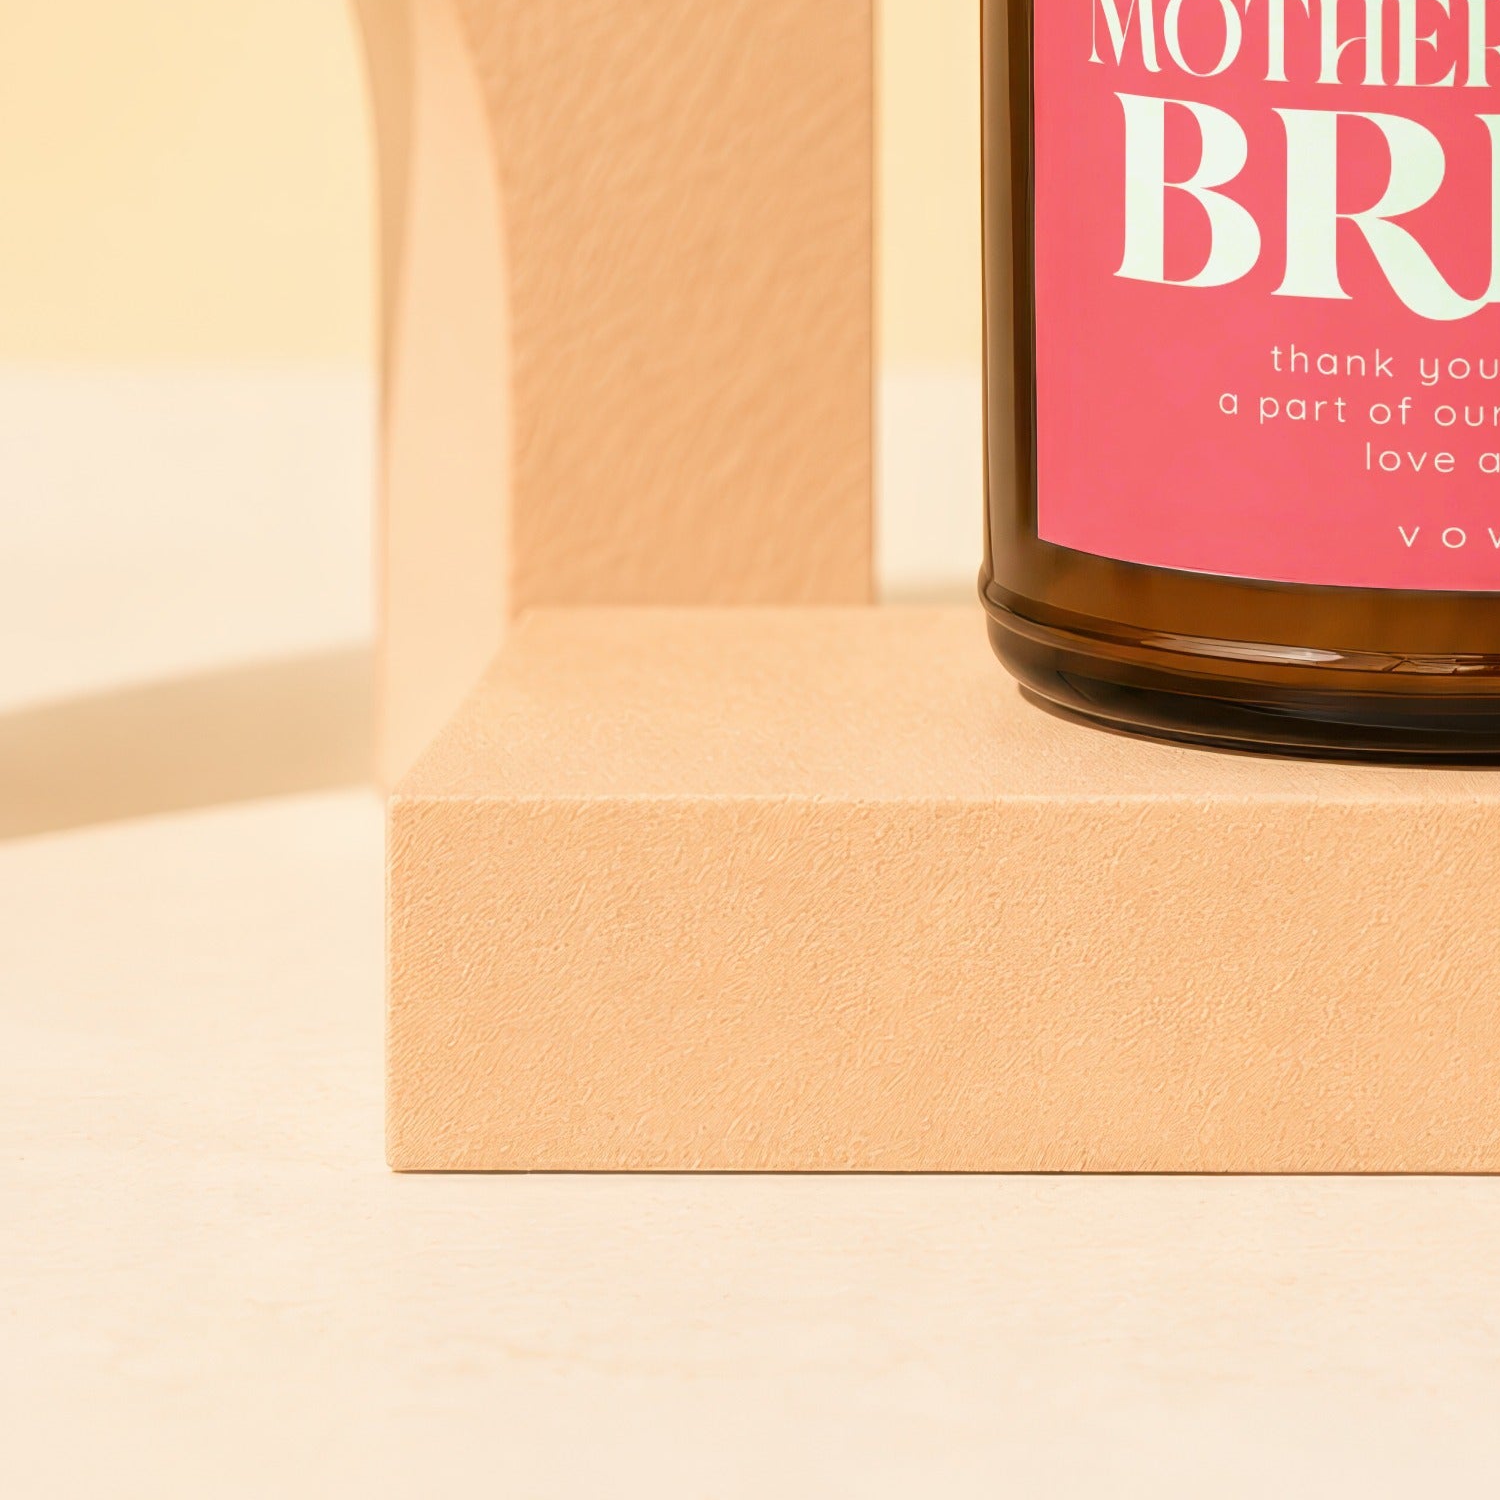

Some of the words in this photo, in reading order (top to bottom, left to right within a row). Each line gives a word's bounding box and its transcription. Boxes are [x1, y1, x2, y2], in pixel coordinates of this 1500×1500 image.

[1270, 342, 1394, 378] thank
[1419, 356, 1499, 387] you
[1218, 392, 1238, 416] a
[1259, 395, 1347, 427] part
[1369, 395, 1412, 426] of
[1366, 441, 1456, 474] love
